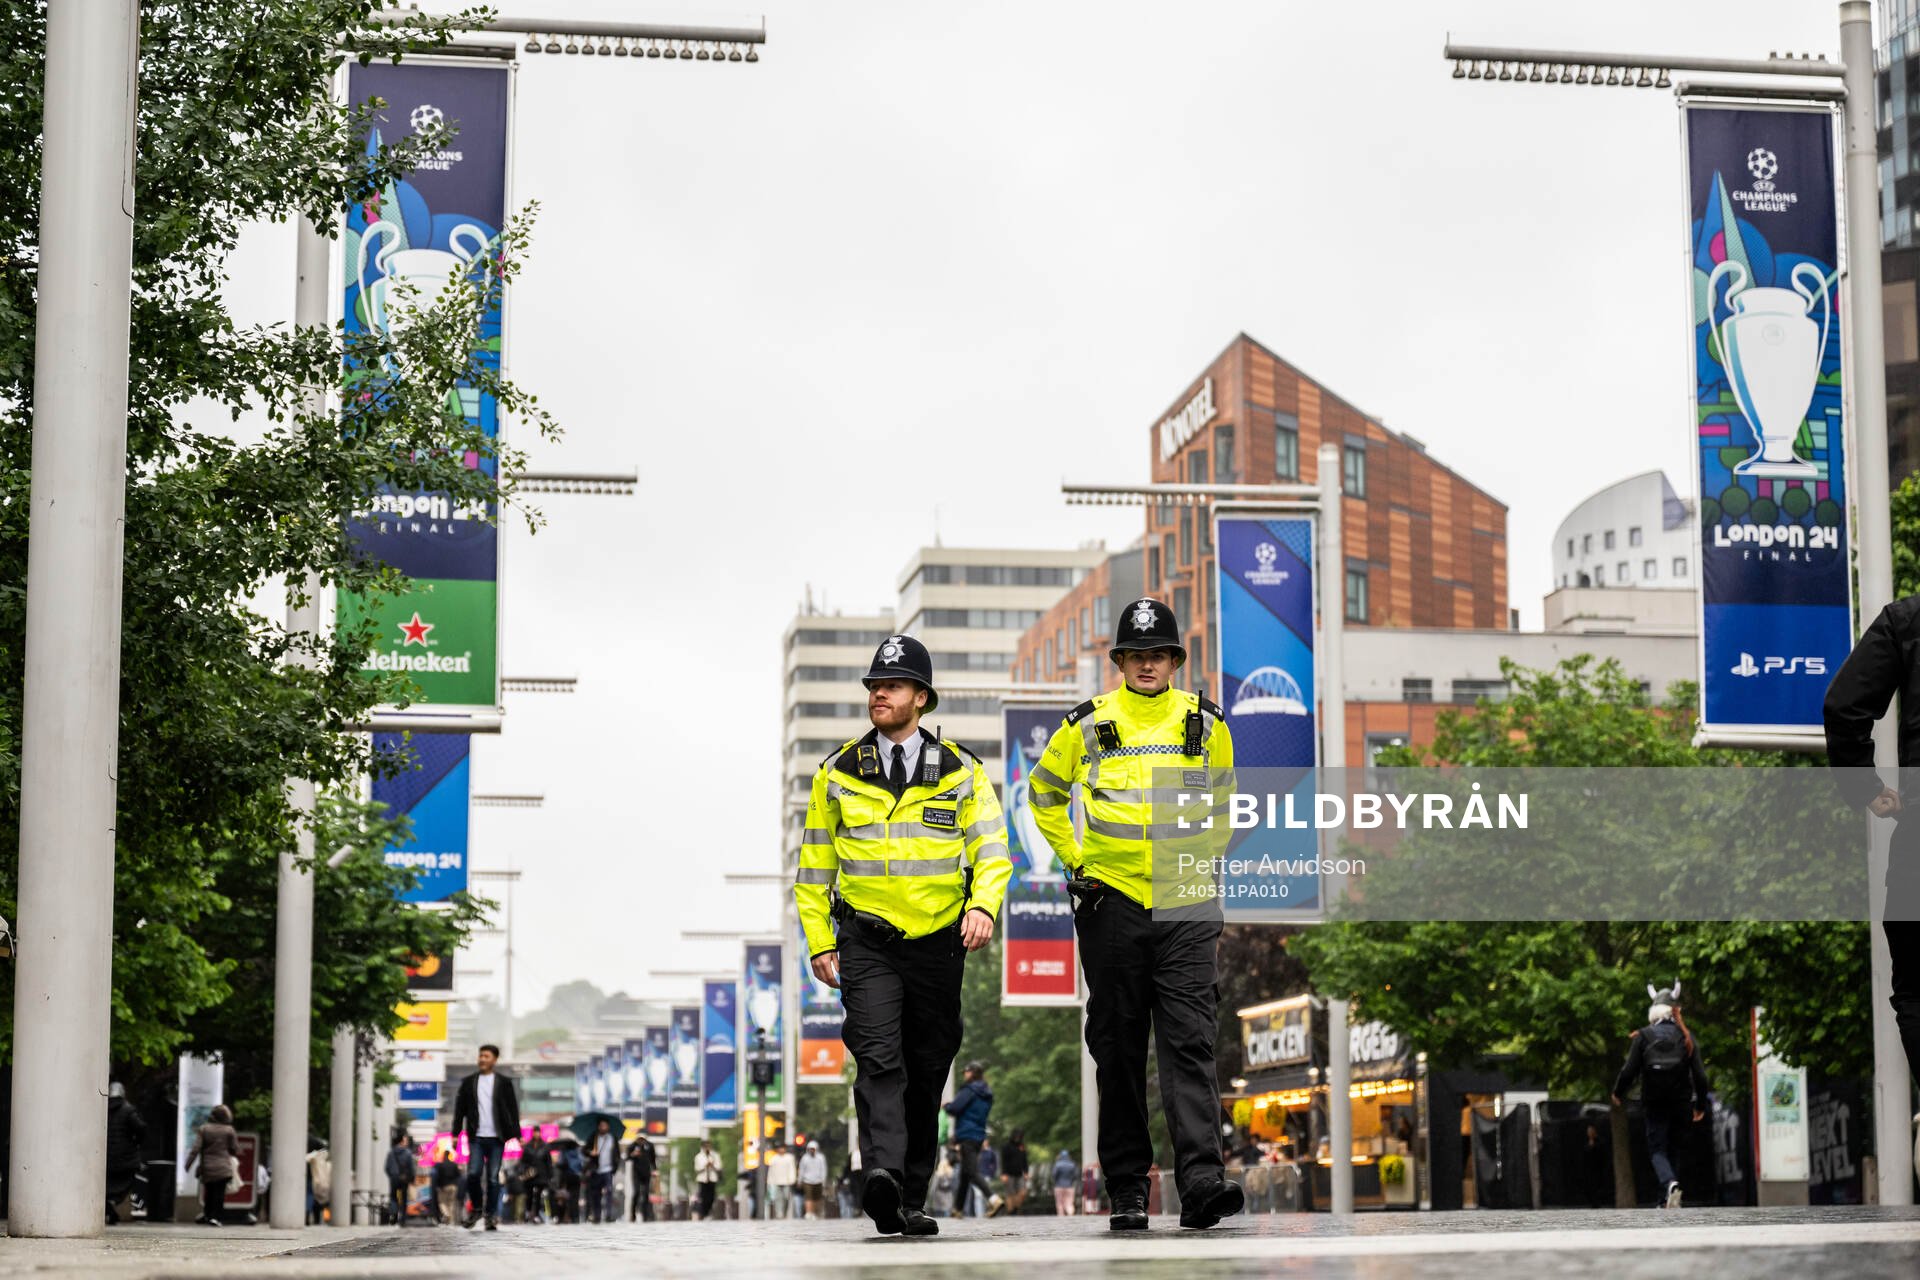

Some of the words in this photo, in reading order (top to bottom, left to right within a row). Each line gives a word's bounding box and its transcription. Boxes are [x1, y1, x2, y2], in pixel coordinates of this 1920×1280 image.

[1732, 190, 1798, 203] CHAMPIONS
[1744, 200, 1787, 212] LEAGUE
[1160, 376, 1217, 464] NOVOTEL
[380, 521, 455, 535] FINAL
[1809, 525, 1838, 549] 24
[1743, 551, 1812, 562] FINAL
[1764, 656, 1826, 675] PS5
[438, 852, 462, 869] 24
[1247, 1025, 1307, 1066] CHICKEN
